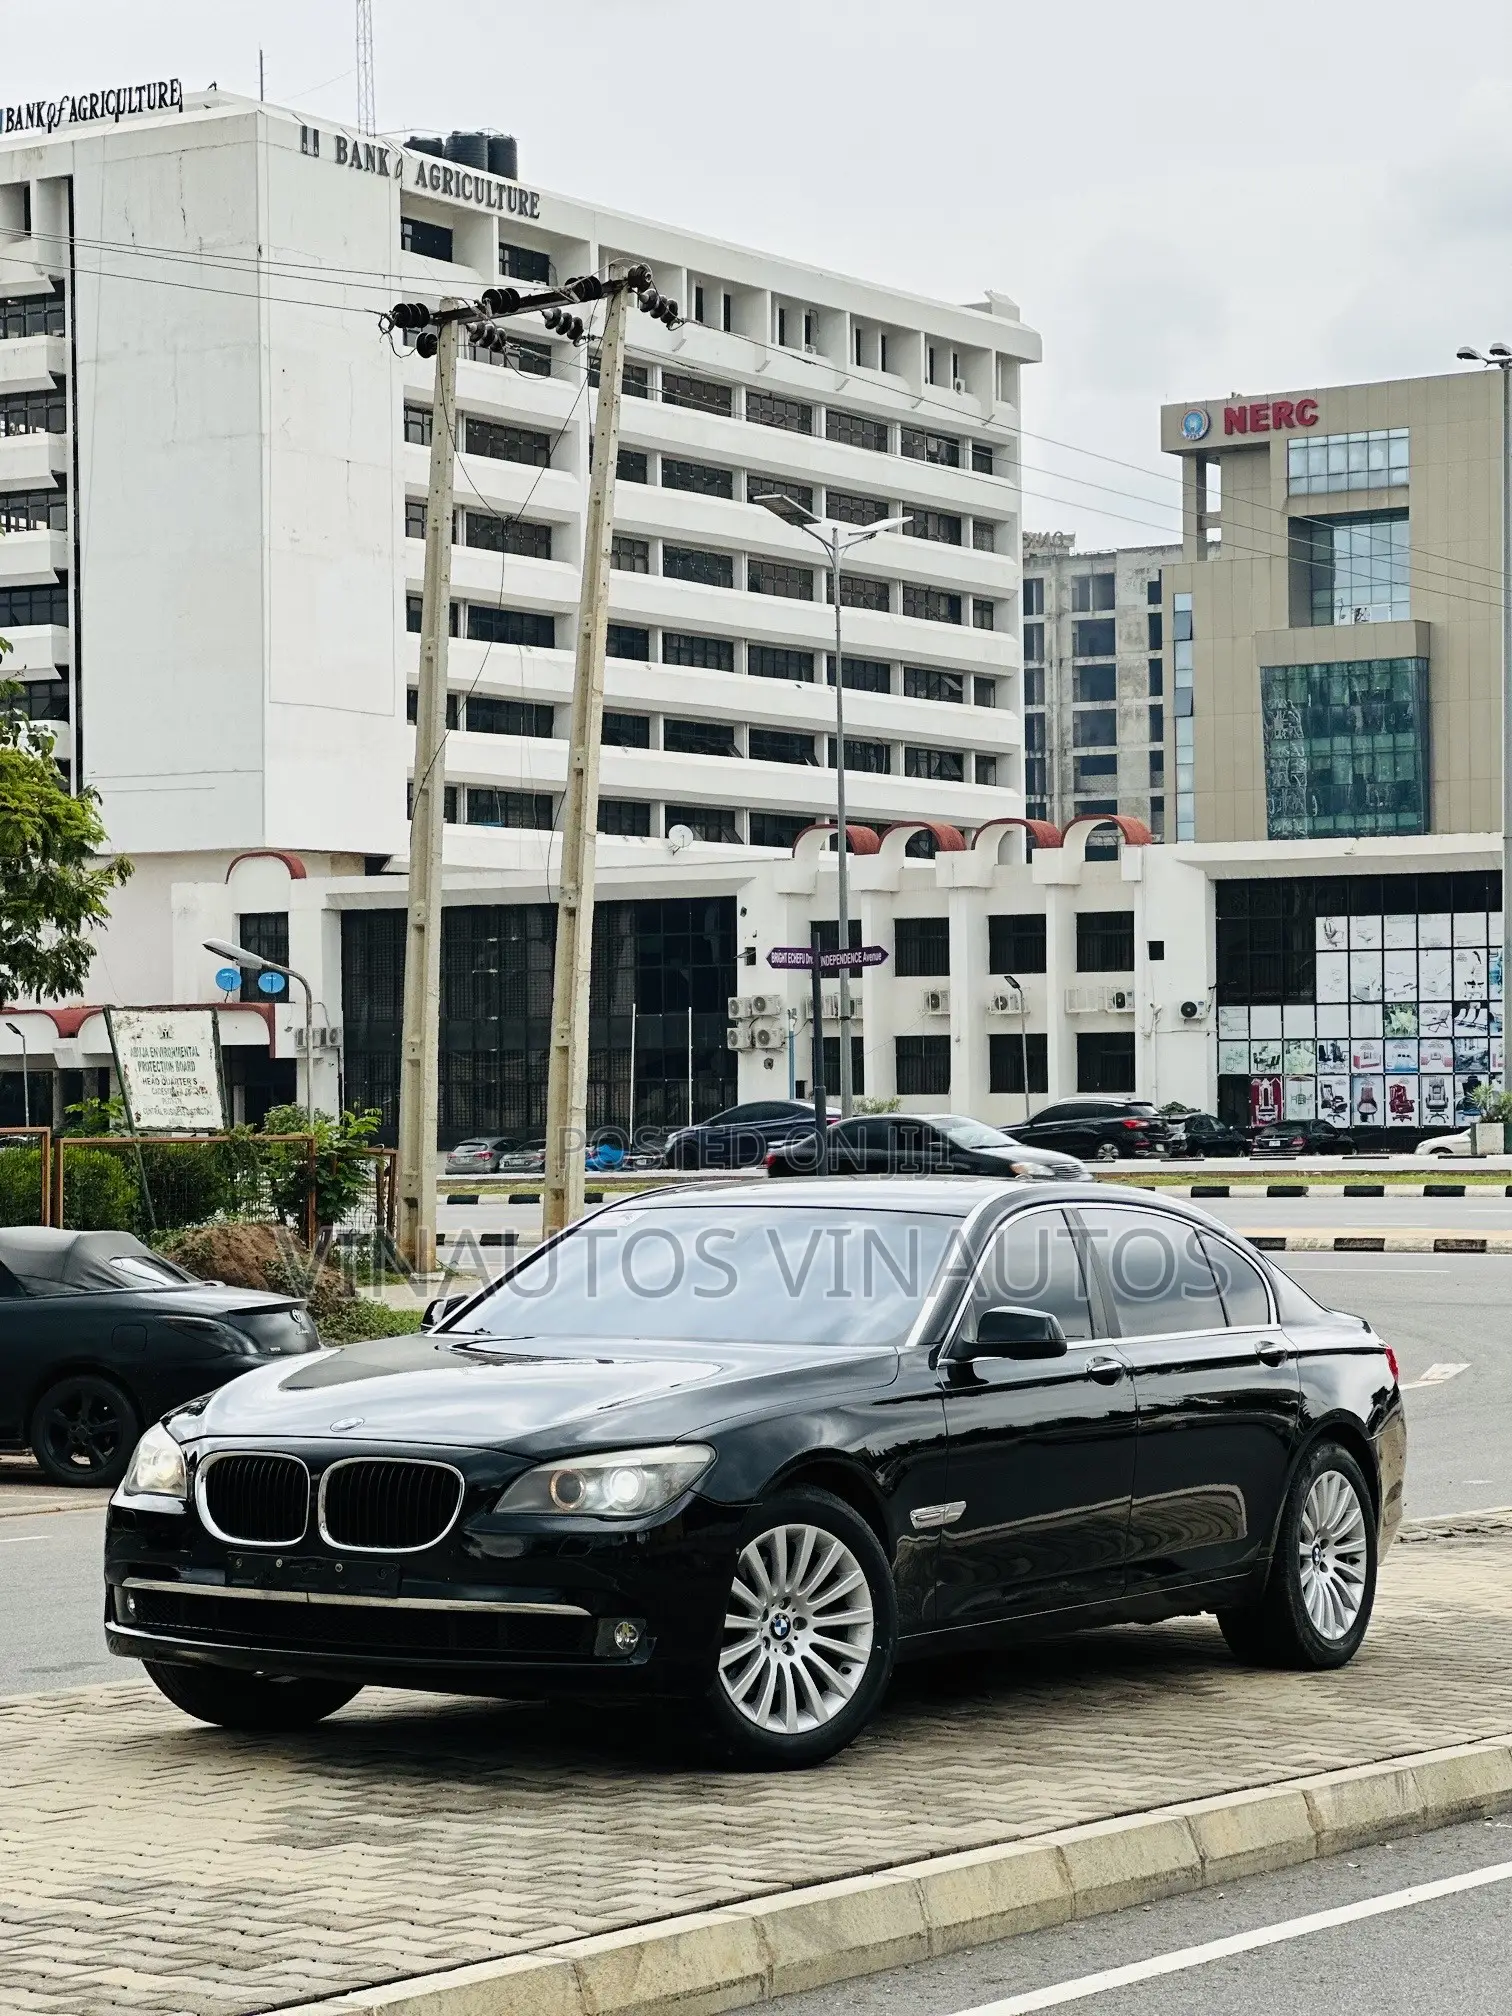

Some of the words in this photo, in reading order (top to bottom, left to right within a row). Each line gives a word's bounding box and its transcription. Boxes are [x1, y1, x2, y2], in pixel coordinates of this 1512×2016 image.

[5, 101, 46, 133] BANK
[47, 95, 69, 127] of
[69, 78, 180, 122] AGRICULTURE
[334, 134, 390, 177] BANK
[415, 159, 540, 219] AGRICULTURE
[1224, 399, 1319, 435] NERC
[820, 952, 862, 966] INDEPENDENCE
[863, 951, 882, 962] Avenue
[150, 1046, 200, 1058] ENVIRONMENTAL
[138, 1061, 175, 1073] PROTECTION
[176, 1061, 196, 1073] BOARD
[142, 1077, 160, 1086] HEAD
